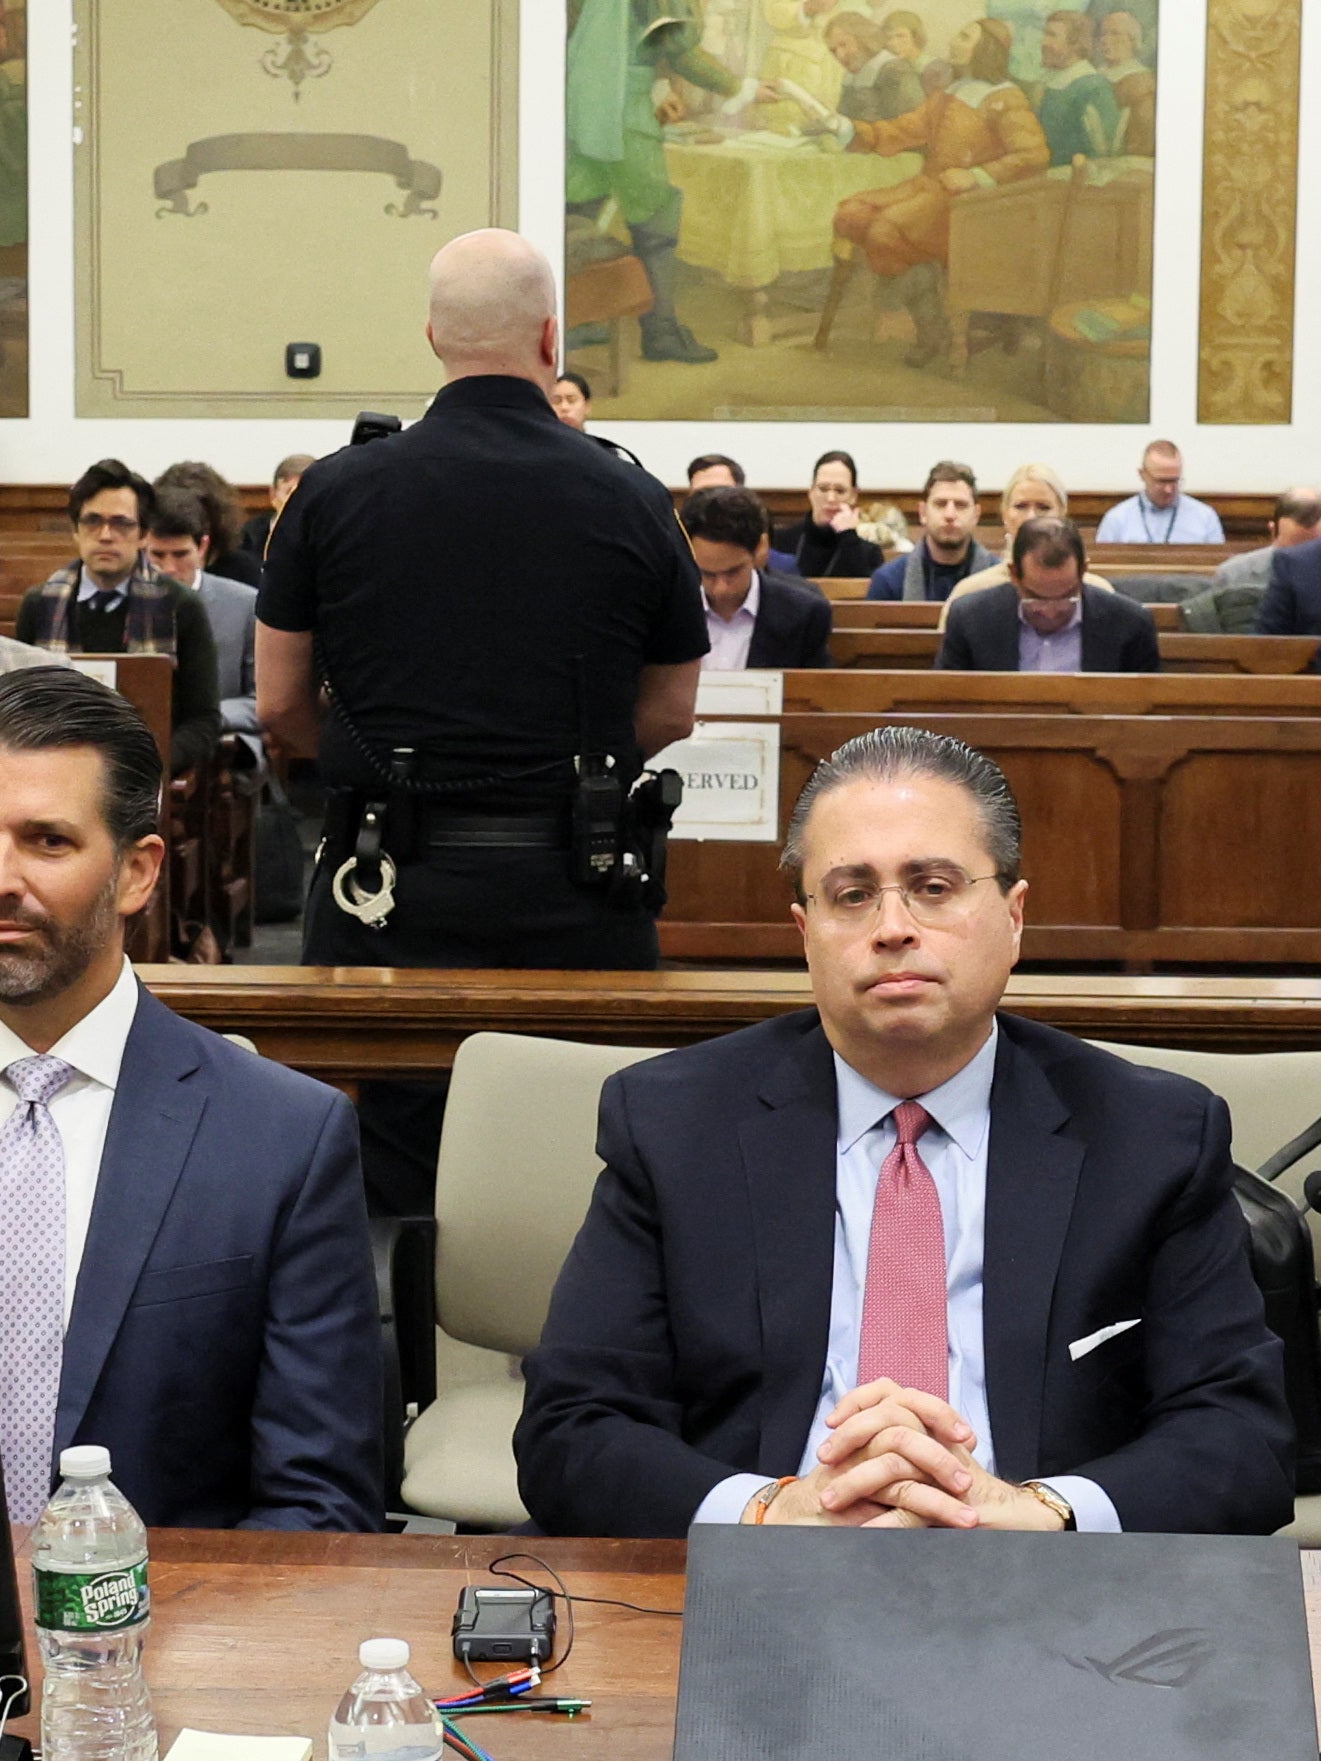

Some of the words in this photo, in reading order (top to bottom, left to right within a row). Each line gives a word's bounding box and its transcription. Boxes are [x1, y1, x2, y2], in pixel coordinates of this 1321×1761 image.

[688, 773, 759, 790] ERVED
[80, 1568, 136, 1605] Poland
[84, 1587, 138, 1623] Spring
